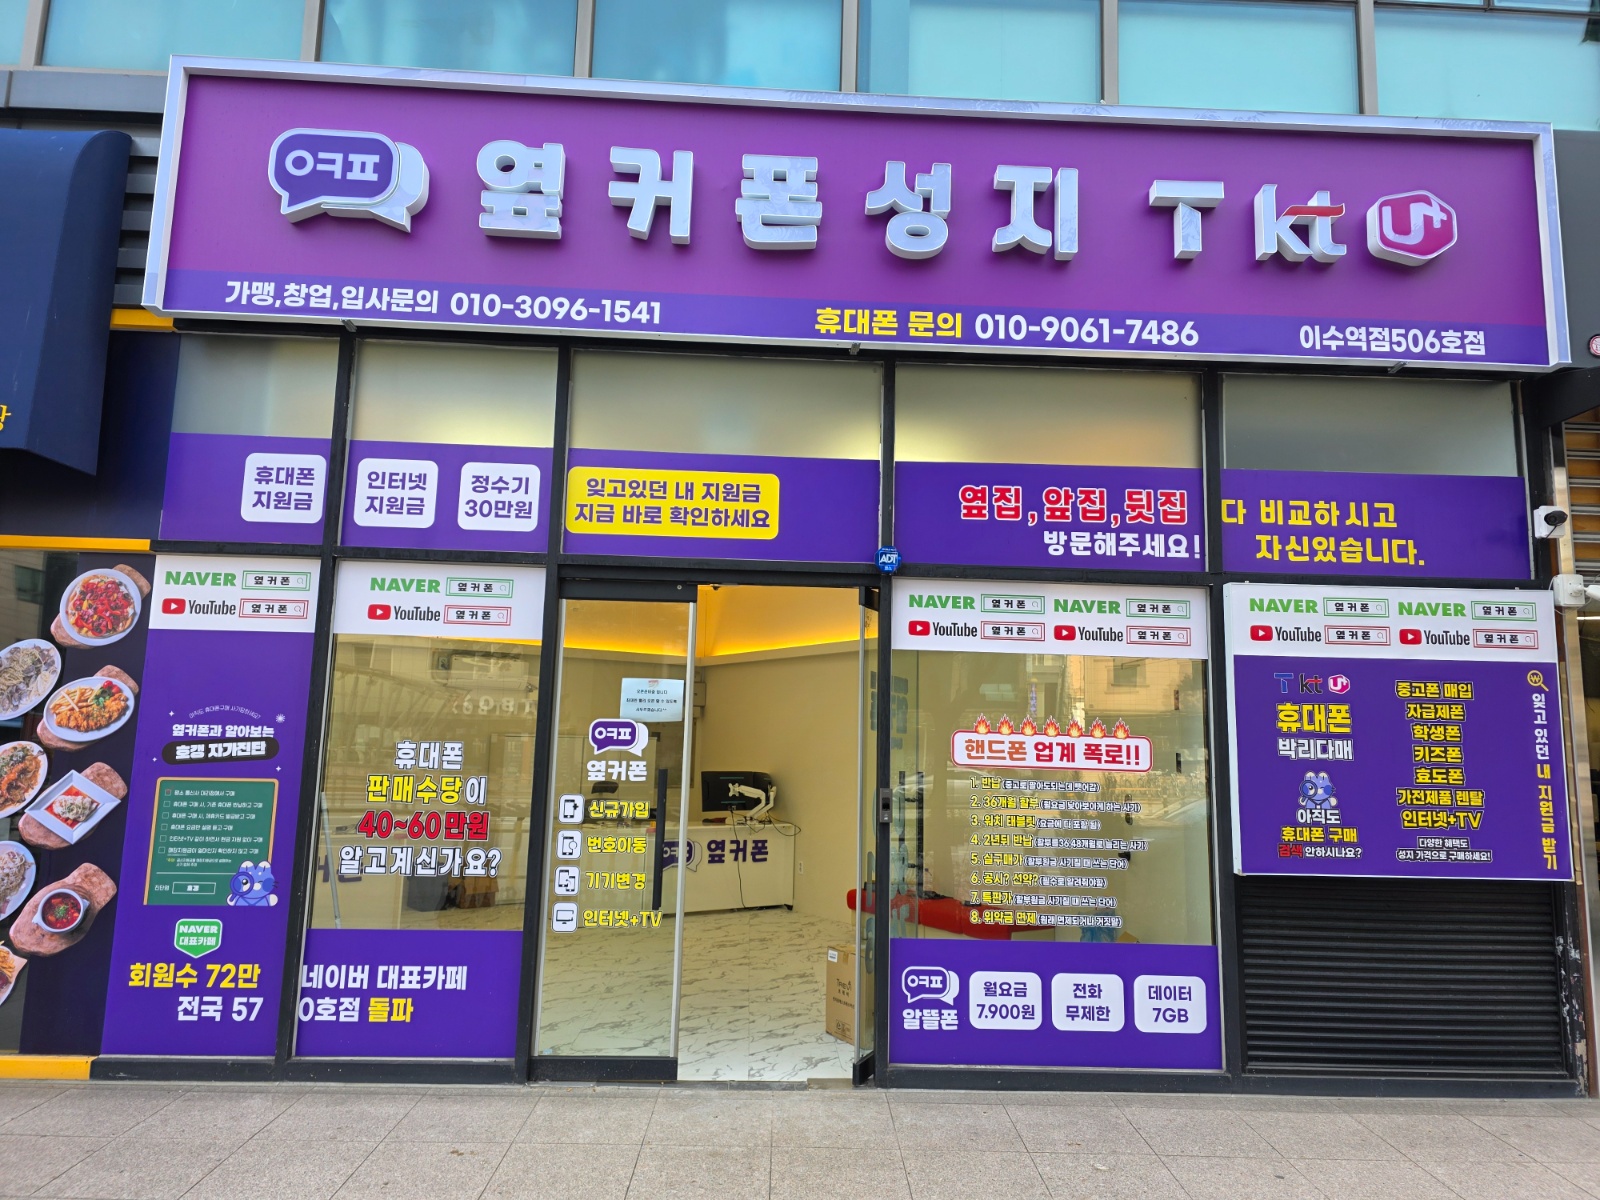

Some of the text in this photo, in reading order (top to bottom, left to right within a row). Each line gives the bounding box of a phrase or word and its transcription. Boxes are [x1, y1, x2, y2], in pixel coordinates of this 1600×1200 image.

[1149, 180, 1224, 260] T
[1254, 184, 1346, 263] kt
[226, 281, 661, 324] 가맹,창업,입사문의 010-3096-1541
[815, 307, 1199, 347] 휴대폰 문의 010-9061-7486
[1299, 324, 1486, 354] 이수역점506호점
[254, 466, 315, 486] 휴대폰
[367, 471, 427, 491] 인터넷
[471, 475, 530, 494] 정수기
[587, 478, 761, 502] 잊고있던 내 지원금
[252, 491, 312, 510] 지원금
[365, 496, 425, 516] 지원금
[465, 500, 532, 520] 30만원
[575, 504, 770, 528] 지금 바로 확인하세요
[1222, 500, 1246, 526] 다
[1044, 530, 1425, 566] 방문해주세요! 자신있습니다.
[880, 554, 898, 564] ADT
[165, 571, 236, 586] NAVER
[370, 577, 440, 593] NAVER
[188, 600, 236, 615] YouTube
[909, 594, 975, 610] NAVER
[1054, 598, 1120, 614] NAVER
[1250, 598, 1318, 614] NAVER
[1398, 602, 1466, 618] NAVER
[394, 606, 440, 622] YouTube
[932, 622, 978, 637] YouTube
[1078, 626, 1123, 642] YouTube
[1275, 626, 1322, 642] YouTube
[1424, 630, 1470, 646] YouTube
[1274, 672, 1294, 693] T
[1299, 673, 1322, 694] kt
[1396, 681, 1474, 700] 중고폰 매입
[1276, 702, 1352, 734] 휴대폰
[1406, 702, 1465, 721] 자급제폰
[172, 724, 274, 738] 옆커폰과 알아보는
[1412, 723, 1462, 742] 학생폰
[176, 740, 266, 760] 호갱 자가진단
[394, 740, 463, 770] 휴대폰
[965, 739, 1140, 766] 핸드폰 업계 폭로!!
[1278, 738, 1354, 760] 박리다매
[1413, 746, 1463, 764] 키즈폰
[586, 760, 648, 782] 옆커폰
[1414, 767, 1465, 785] 효도폰
[366, 774, 487, 805] 판매수당이
[970, 776, 1000, 789] 1. 반납
[1532, 693, 1557, 870] 잊고 있던 내 지원금 받기
[970, 796, 981, 807] 2.
[983, 796, 1016, 808] 36개월
[1020, 797, 1039, 809] 할부
[1397, 788, 1484, 807] 가전제품 렌탈
[589, 801, 650, 820] 신규가입
[1296, 808, 1341, 824] 아직도
[1402, 810, 1483, 829] 인터넷+TV
[357, 810, 490, 840] 40~60만원
[970, 814, 1036, 828] 3. 워치 태블릿
[970, 834, 981, 846] 4.
[984, 834, 1010, 846] 2년뒤
[1012, 834, 1033, 848] 반납
[1282, 826, 1358, 843] 휴대폰 구매
[1418, 838, 1469, 848] 다양한 혜택도
[586, 836, 648, 854] 번호이동
[707, 840, 768, 864] 옆커폰
[1278, 844, 1362, 858] 검색 안하시나요?
[339, 846, 502, 877] 알고계신가요?
[970, 853, 981, 864] 5.
[983, 853, 1022, 866] 실구매가
[1397, 850, 1491, 862] 성지 가격으로 구매하세요!
[585, 872, 647, 890] 기기변경
[970, 872, 1038, 886] 6. 공시? 선약?
[970, 891, 980, 903] 7.
[982, 892, 1012, 904] 특판가
[582, 909, 662, 928] 인터넷+TV
[970, 910, 981, 922] 8.
[983, 911, 1014, 924] 위약금
[1016, 912, 1037, 924] 면제
[180, 925, 218, 934] NAVER
[180, 936, 216, 946] 대표카페
[128, 963, 467, 990] 회원수 72만 네이버 대표카페
[983, 981, 1028, 998] 월요금
[1073, 983, 1102, 1000] 전화
[1148, 985, 1192, 1002] 데이터
[178, 996, 223, 1022] 전국
[231, 998, 264, 1022] 57
[368, 998, 414, 1022] 돌파
[976, 1004, 1036, 1020] 7.900원
[1066, 1005, 1110, 1022] 무제한
[1153, 1007, 1189, 1023] 7GB
[902, 1008, 958, 1031] 알뜰폰
